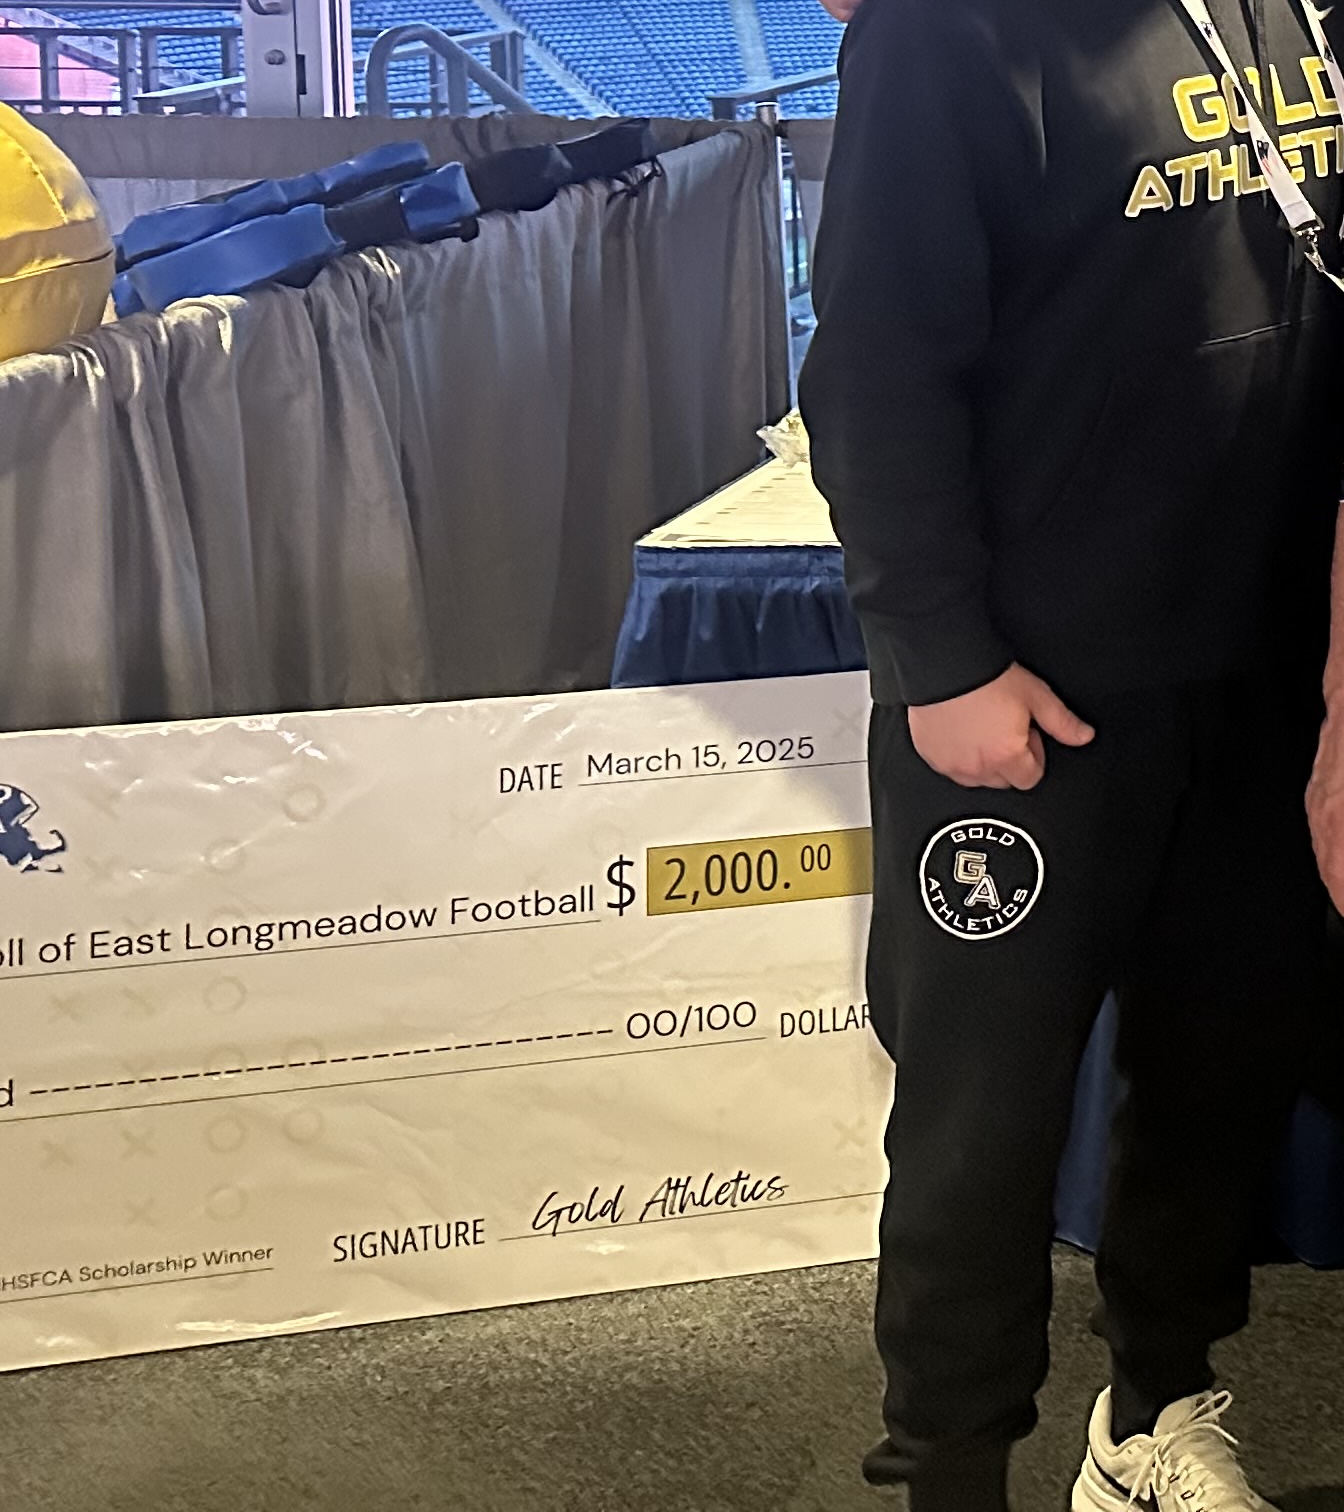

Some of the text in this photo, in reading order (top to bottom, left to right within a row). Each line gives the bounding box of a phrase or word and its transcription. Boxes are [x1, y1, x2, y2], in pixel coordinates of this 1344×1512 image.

[500, 736, 815, 794] DATE March 15, 2025
[950, 828, 1015, 846] GOLD
[38, 933, 76, 963] of
[90, 929, 171, 959] East
[185, 904, 437, 951] Longmeadow
[450, 884, 594, 925] Football
[928, 877, 1028, 931] ATHLETICS
[332, 1169, 790, 1263] SIGNATURE Gold Athletics
[79, 1255, 197, 1282] Scholarship
[202, 1247, 274, 1266] Winner
